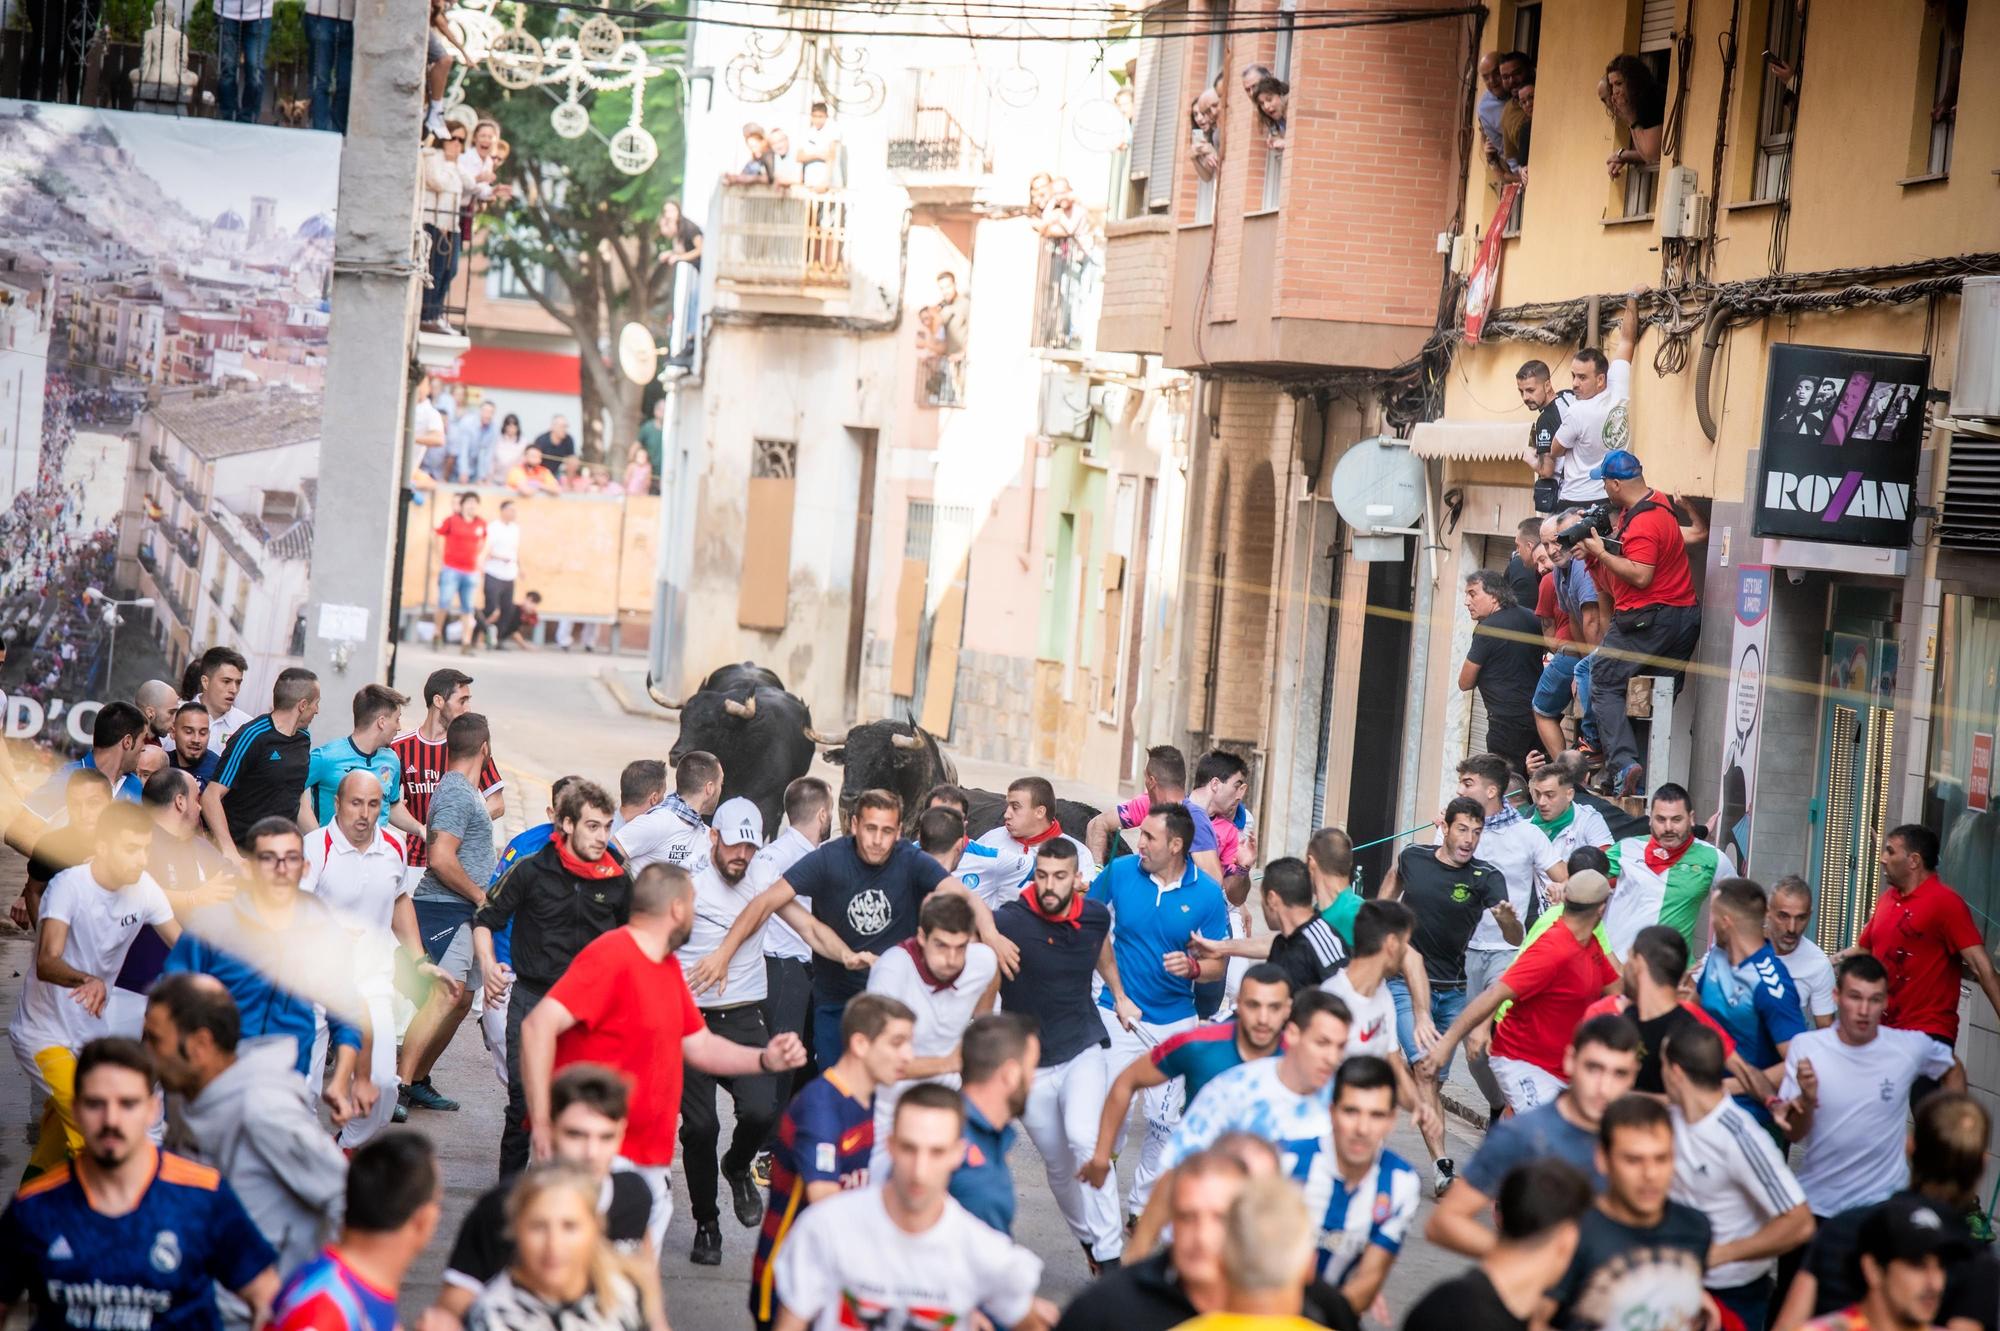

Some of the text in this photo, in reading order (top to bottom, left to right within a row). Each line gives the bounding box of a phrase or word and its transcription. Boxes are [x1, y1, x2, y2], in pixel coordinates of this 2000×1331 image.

[1765, 471, 1910, 522] ROYAN
[424, 769, 440, 783] Fly
[48, 1278, 172, 1314] Emirates
